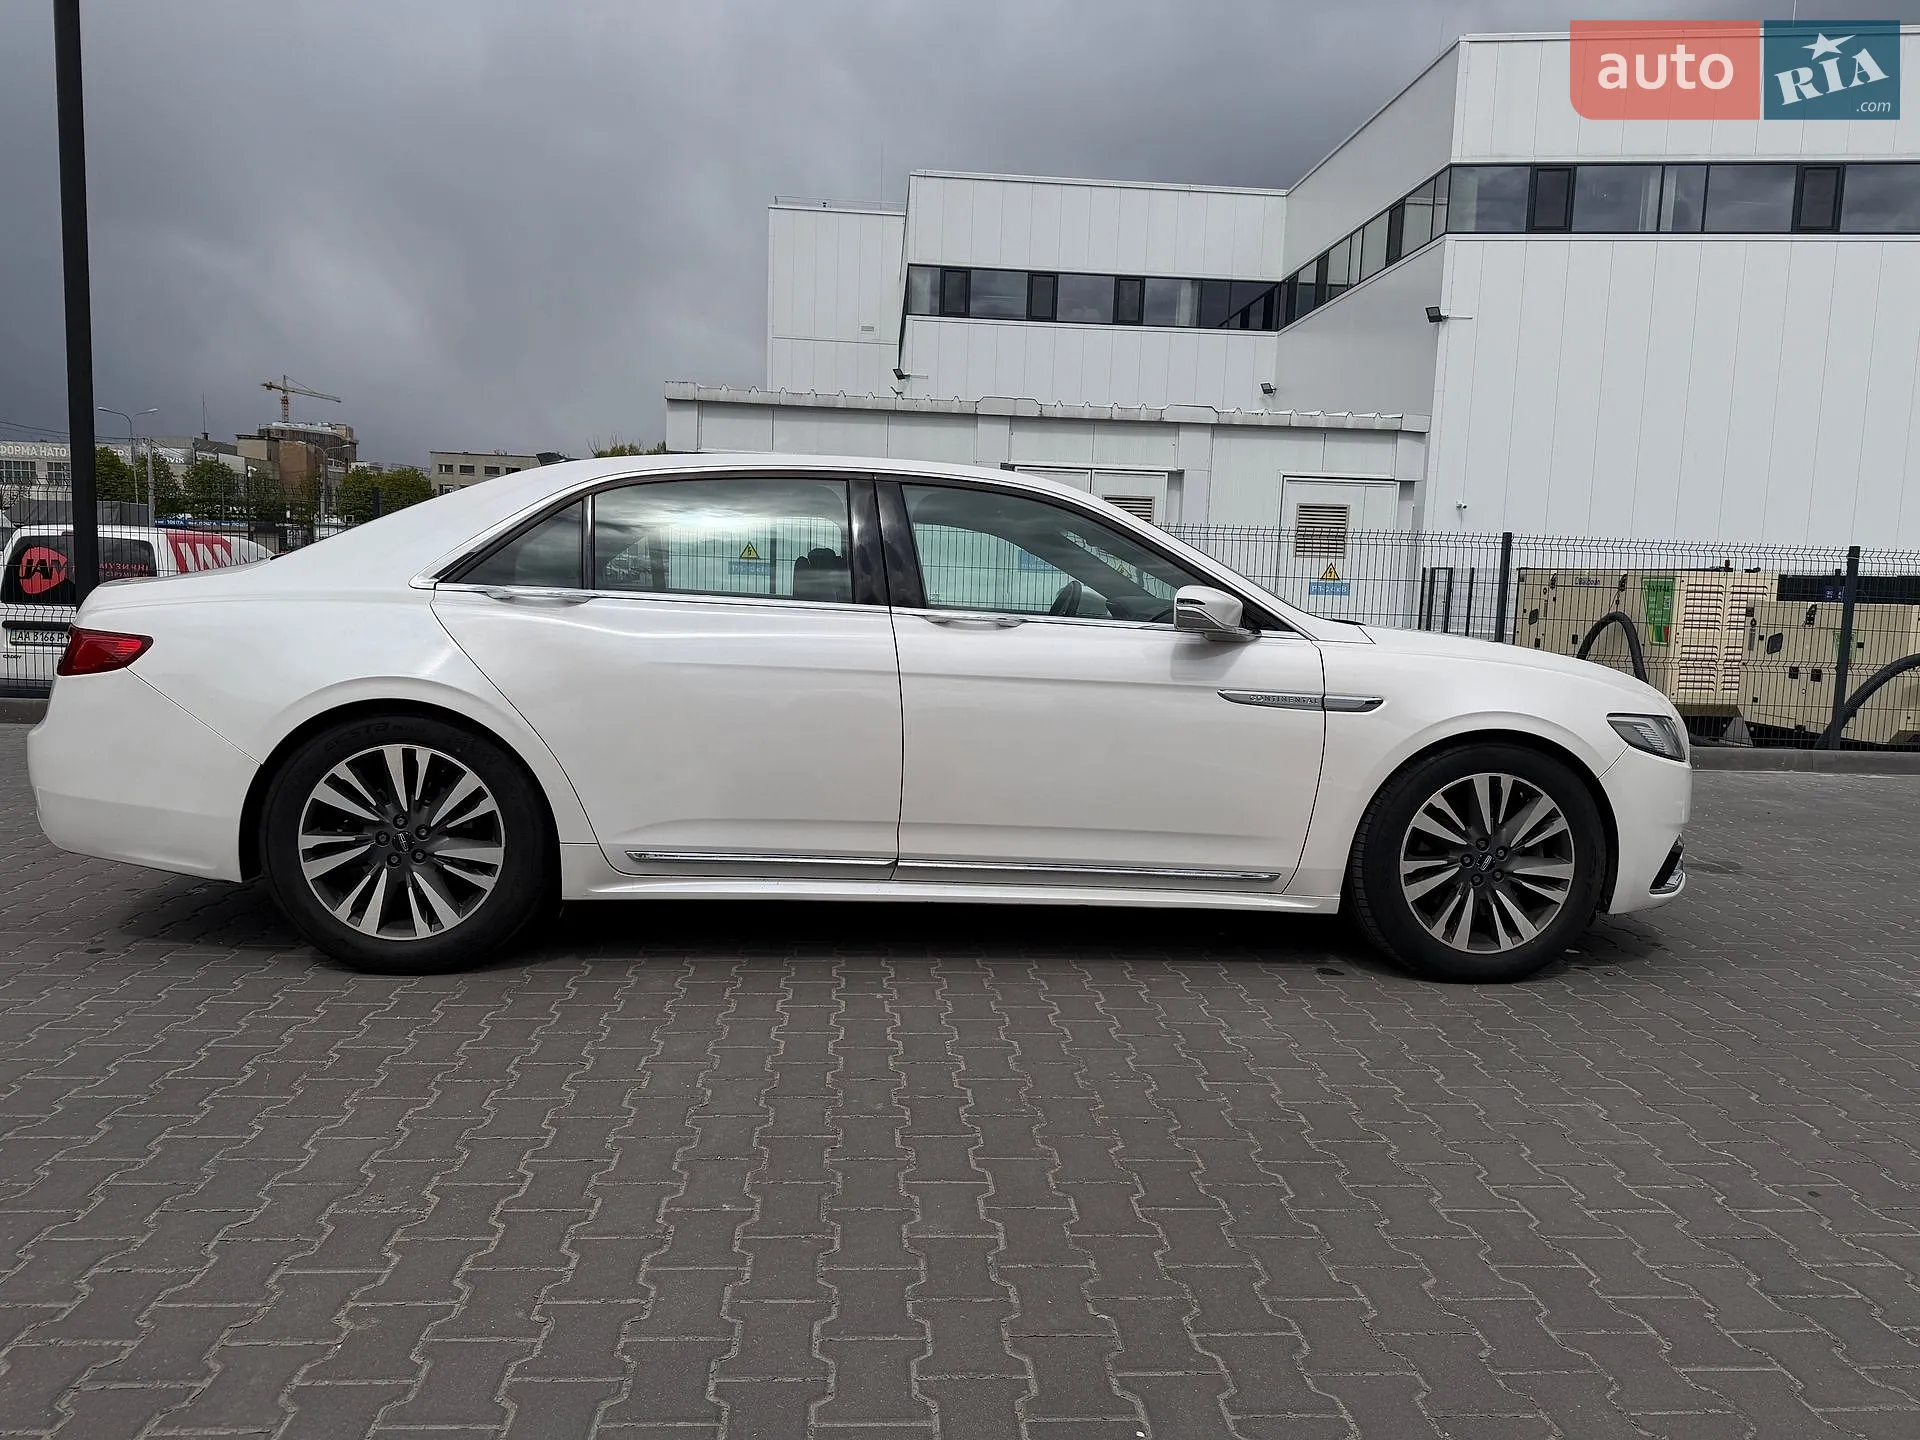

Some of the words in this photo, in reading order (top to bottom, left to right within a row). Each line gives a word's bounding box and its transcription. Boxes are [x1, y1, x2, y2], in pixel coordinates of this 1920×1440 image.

[39, 446, 67, 457] НАТО
[20, 558, 67, 580] JAM
[1249, 695, 1319, 704] CONTINENTAL
